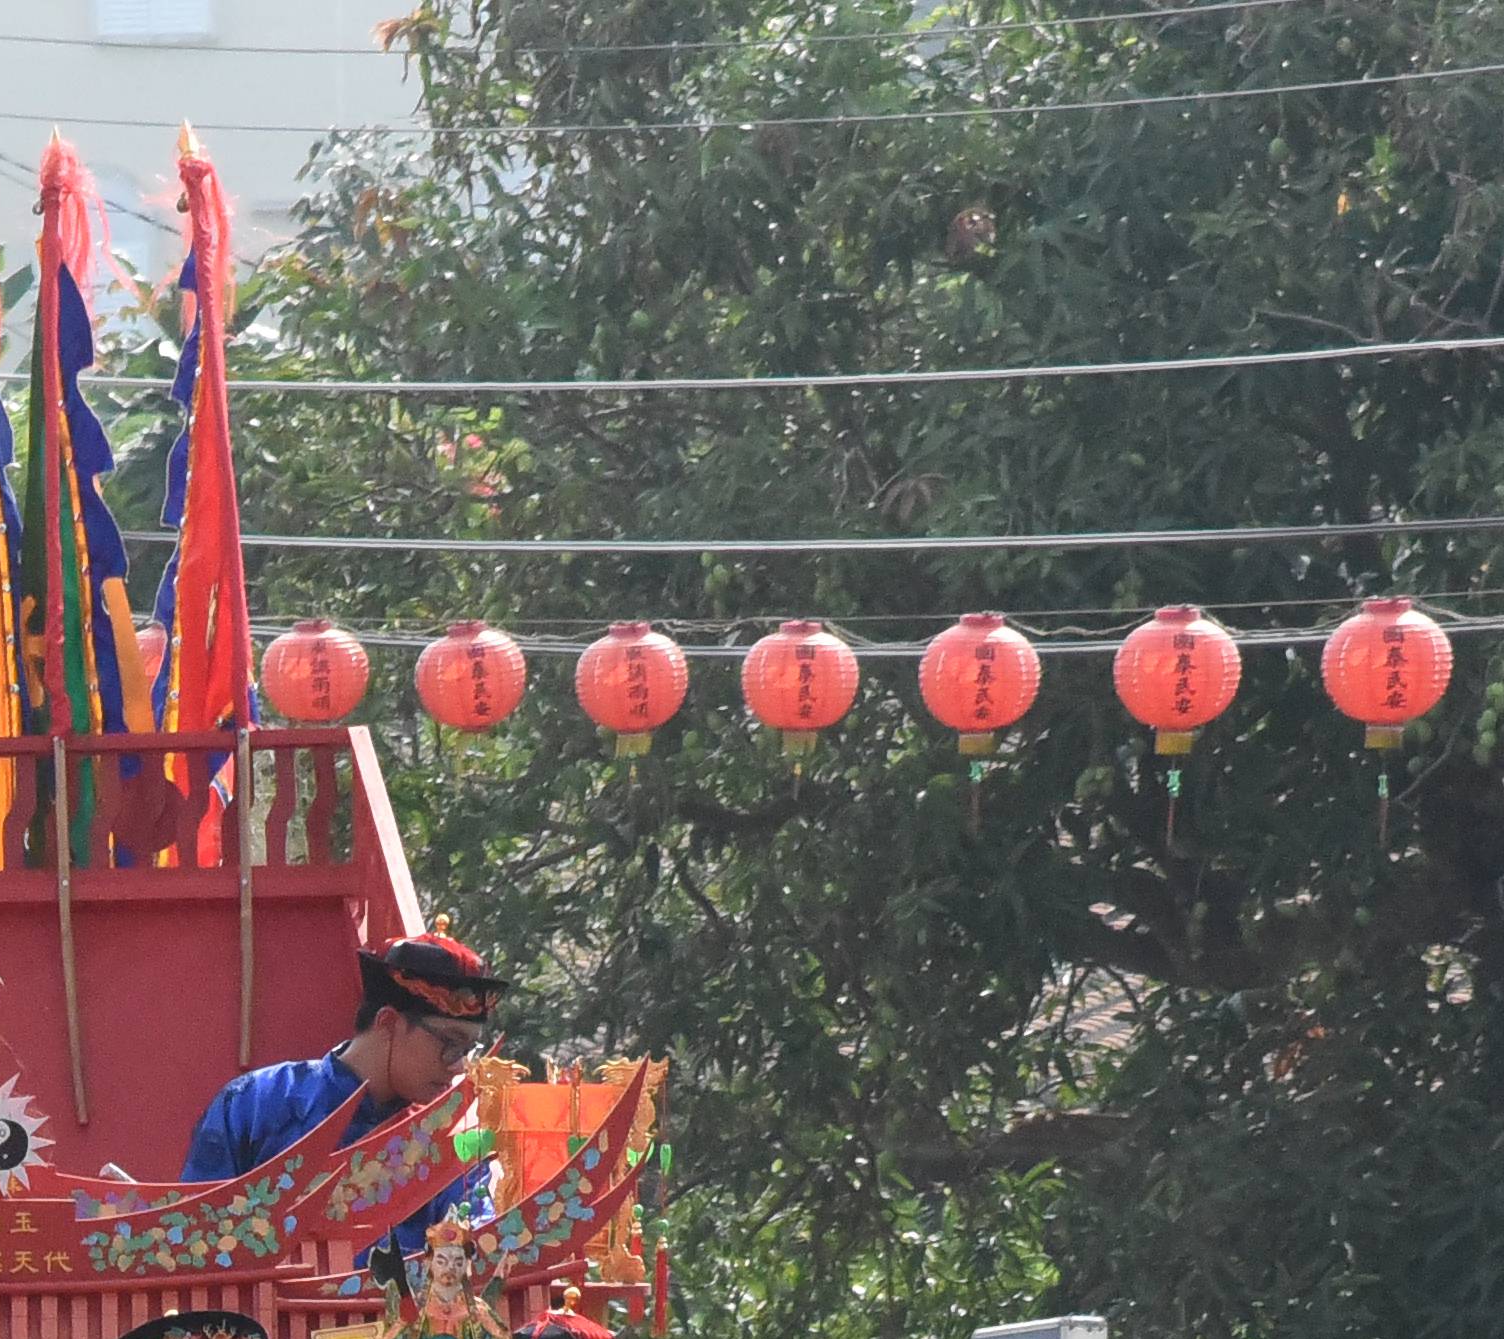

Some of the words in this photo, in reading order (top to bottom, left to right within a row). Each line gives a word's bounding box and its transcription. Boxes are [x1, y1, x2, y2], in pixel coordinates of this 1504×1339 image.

[795, 643, 818, 720] 國泰民安
[973, 646, 996, 721] 國泰民安
[1171, 633, 1198, 716] 國泰民安
[1381, 626, 1408, 710] 國泰民安
